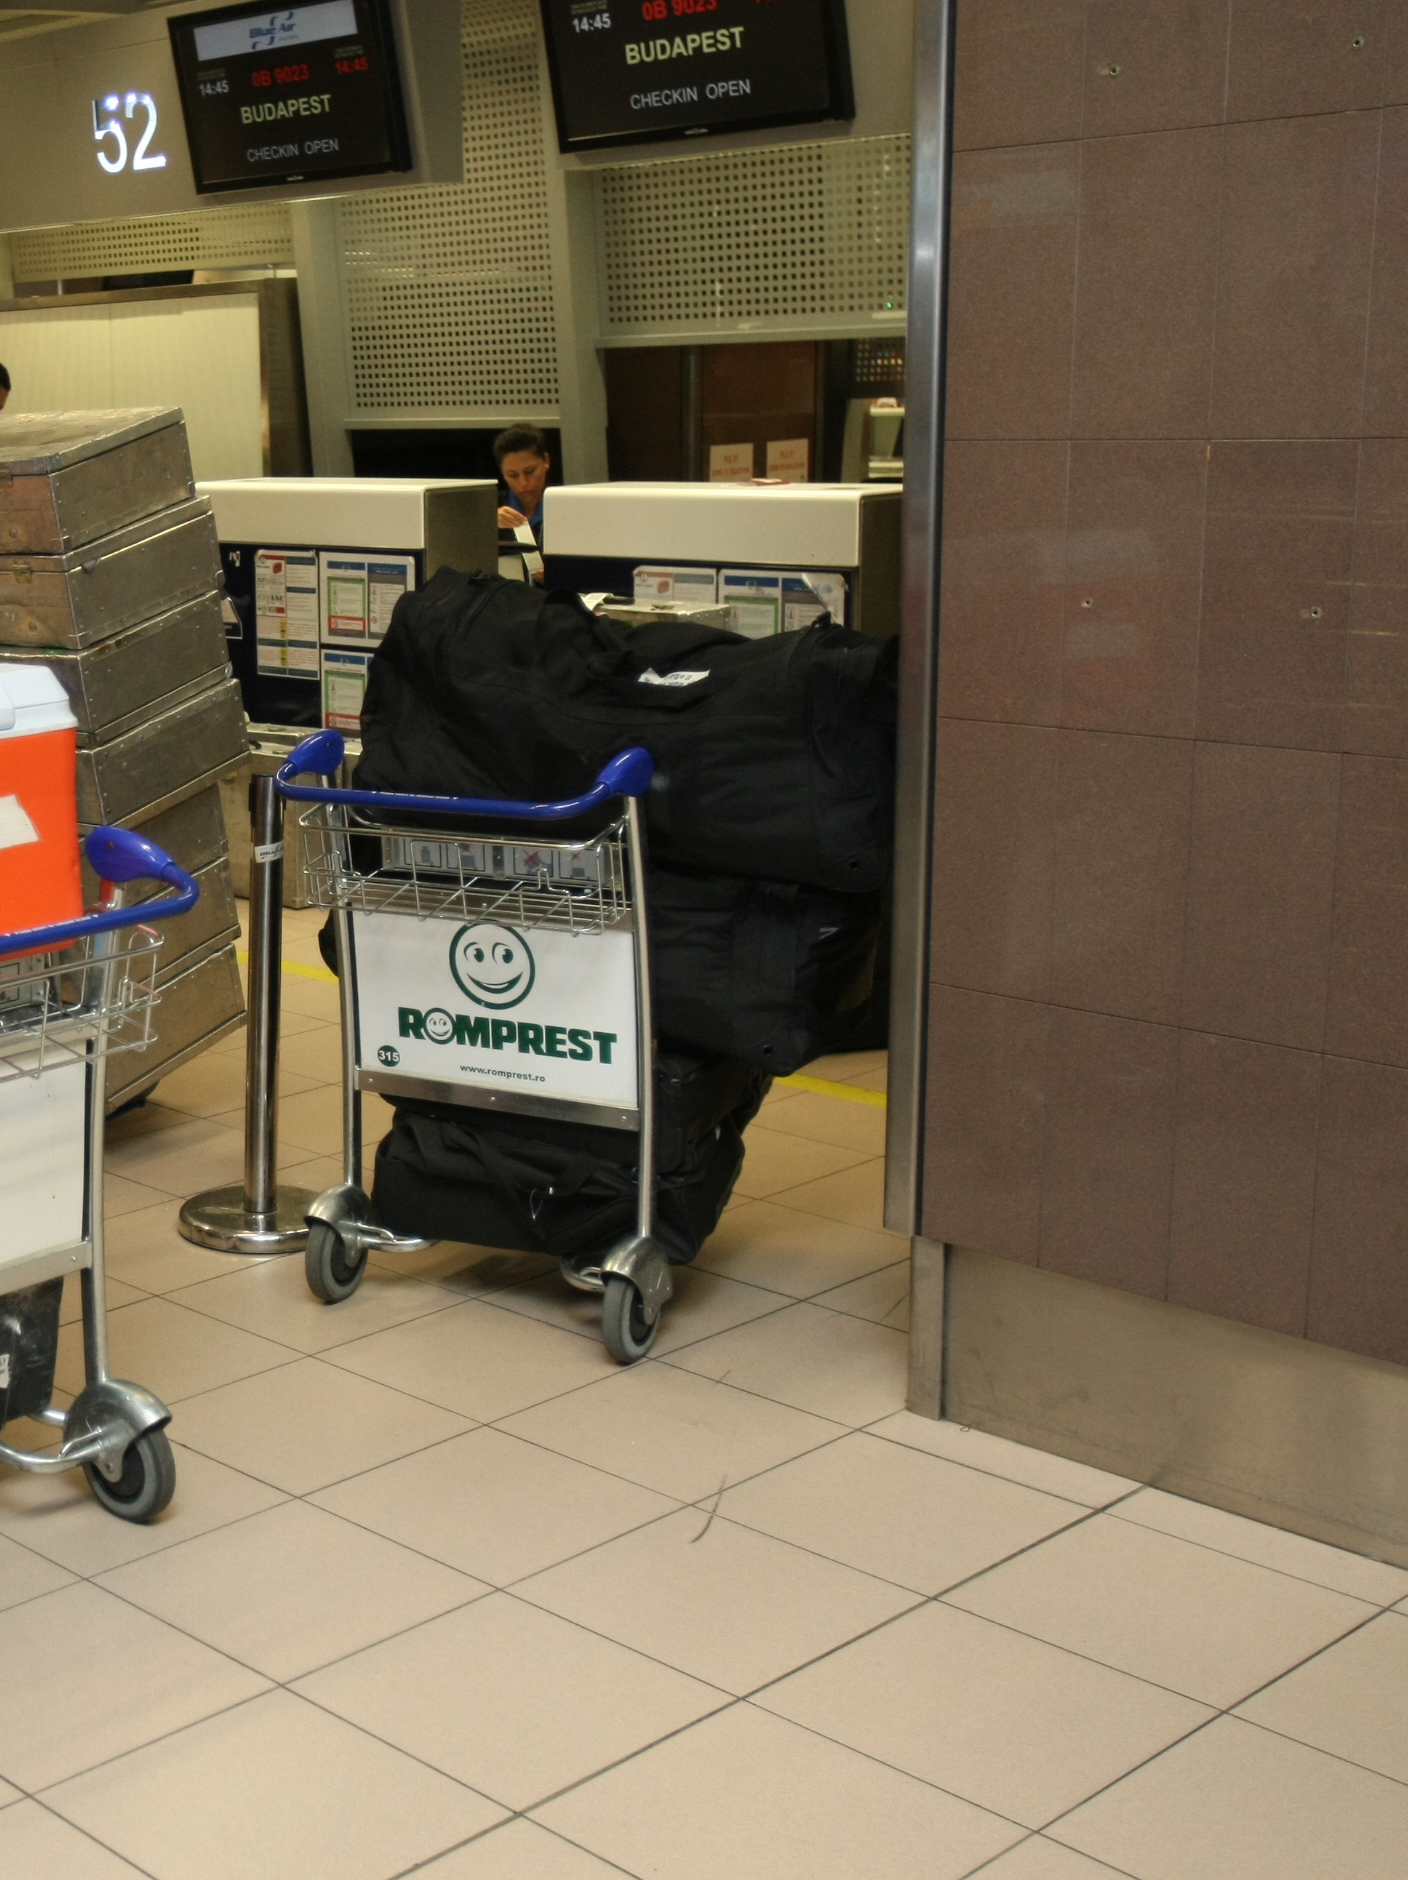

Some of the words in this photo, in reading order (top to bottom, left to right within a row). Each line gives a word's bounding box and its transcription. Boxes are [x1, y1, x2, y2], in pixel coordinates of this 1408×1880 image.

[249, 26, 276, 39] Blue
[572, 13, 611, 32] 14:45
[624, 27, 744, 64] BUDAPEST
[274, 63, 310, 84] 9023
[198, 80, 229, 97] 14:45
[630, 86, 698, 110] CHECKIN
[705, 79, 751, 100] OPEN
[240, 94, 332, 125] BUDAPEST
[92, 93, 167, 174] 52
[246, 143, 298, 162] CHECKIN
[304, 138, 339, 155] OPEN
[398, 1007, 617, 1064] ROMPREST
[378, 1050, 400, 1063] 315
[459, 1065, 546, 1082] www.romprest.ro
